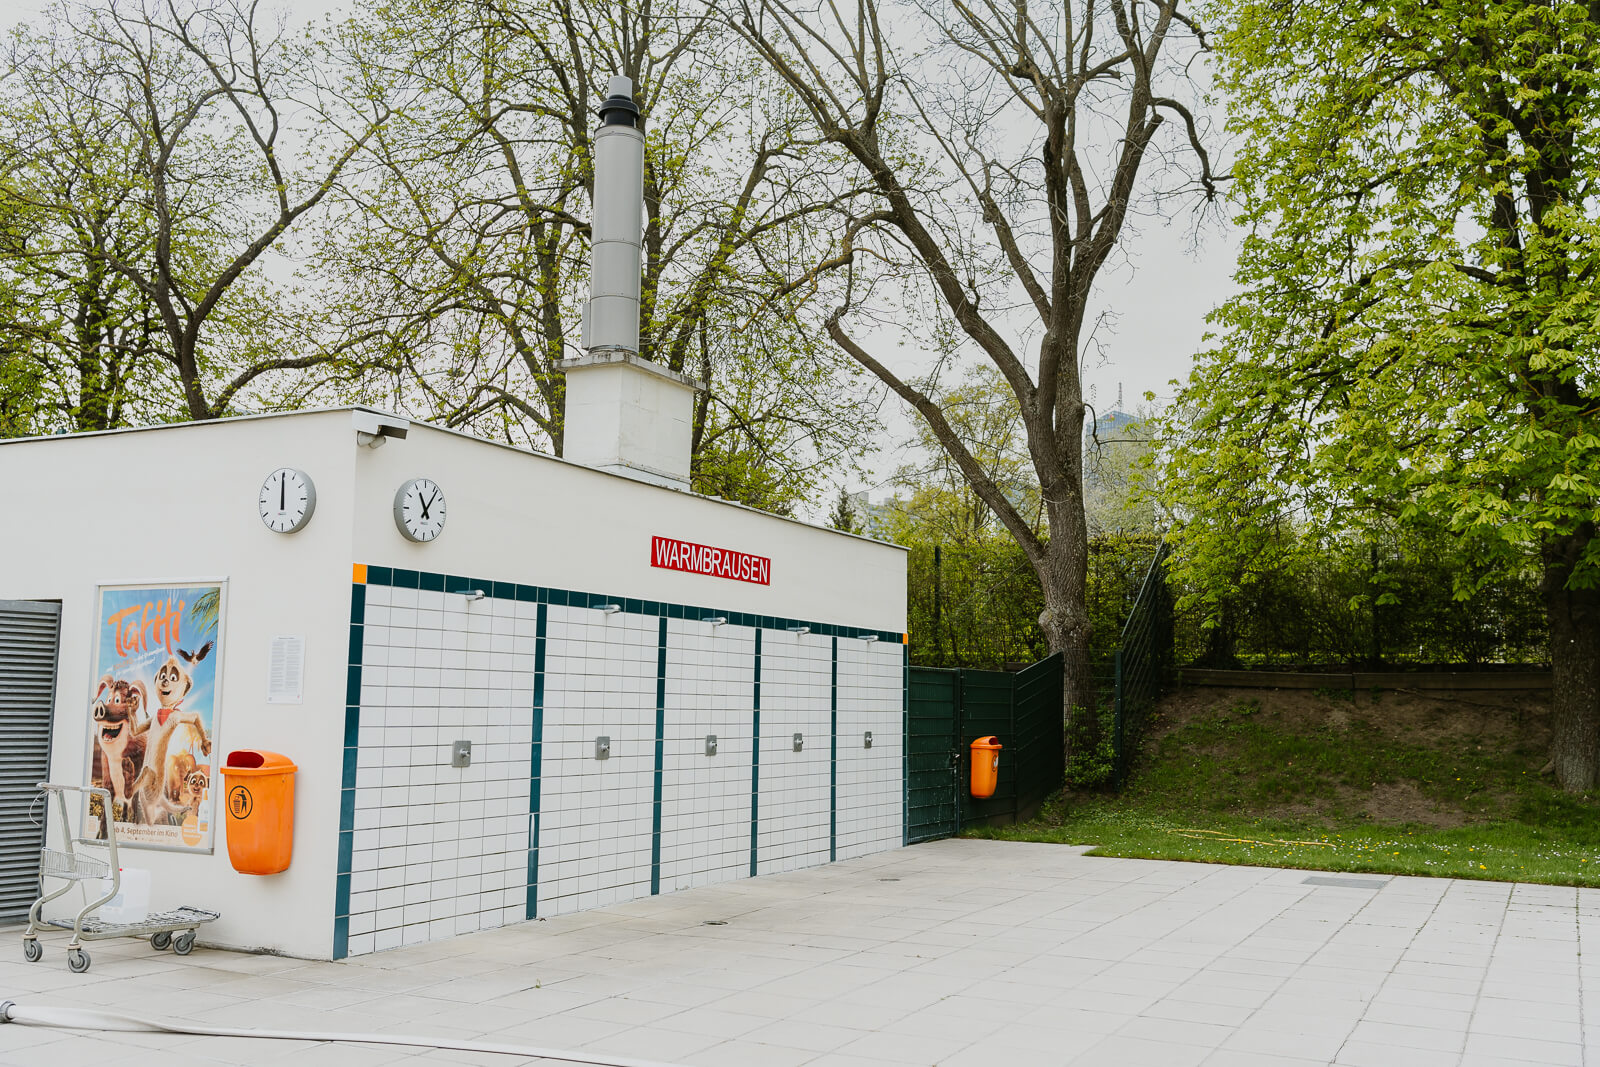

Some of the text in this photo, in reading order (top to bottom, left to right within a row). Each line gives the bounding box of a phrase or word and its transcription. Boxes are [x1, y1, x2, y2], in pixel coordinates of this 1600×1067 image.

[655, 538, 768, 583] WARMBRAUSEN
[107, 597, 186, 657] Tafiti
[127, 827, 156, 836] September
[165, 829, 178, 837] Kino
